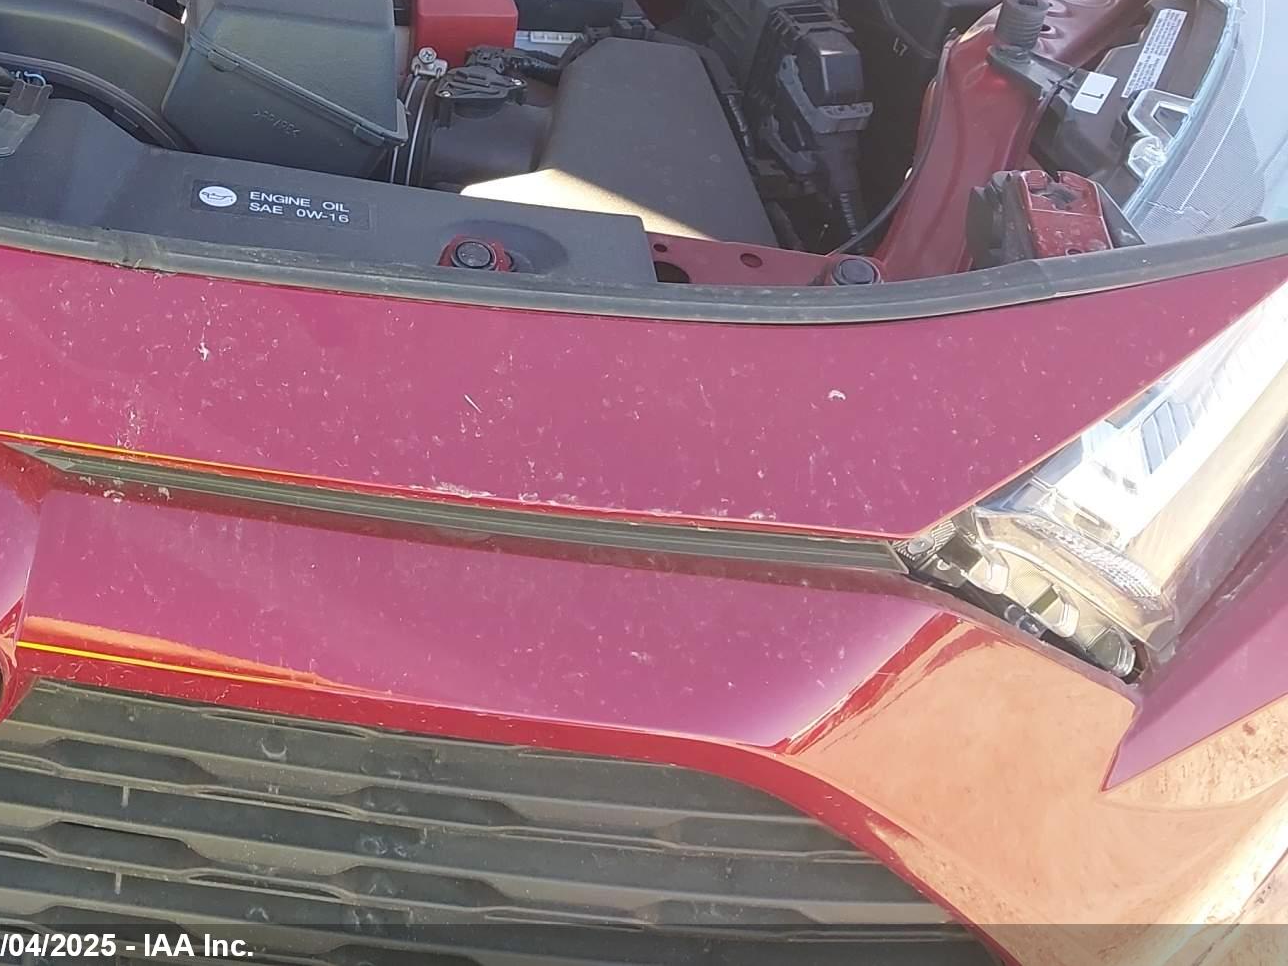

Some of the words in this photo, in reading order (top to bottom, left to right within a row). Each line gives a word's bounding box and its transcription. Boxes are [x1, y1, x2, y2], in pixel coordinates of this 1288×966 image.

[248, 202, 283, 215] SAE
[296, 208, 350, 223] 0W-16
[249, 191, 311, 207] ENGINE
[322, 201, 350, 213] OIL
